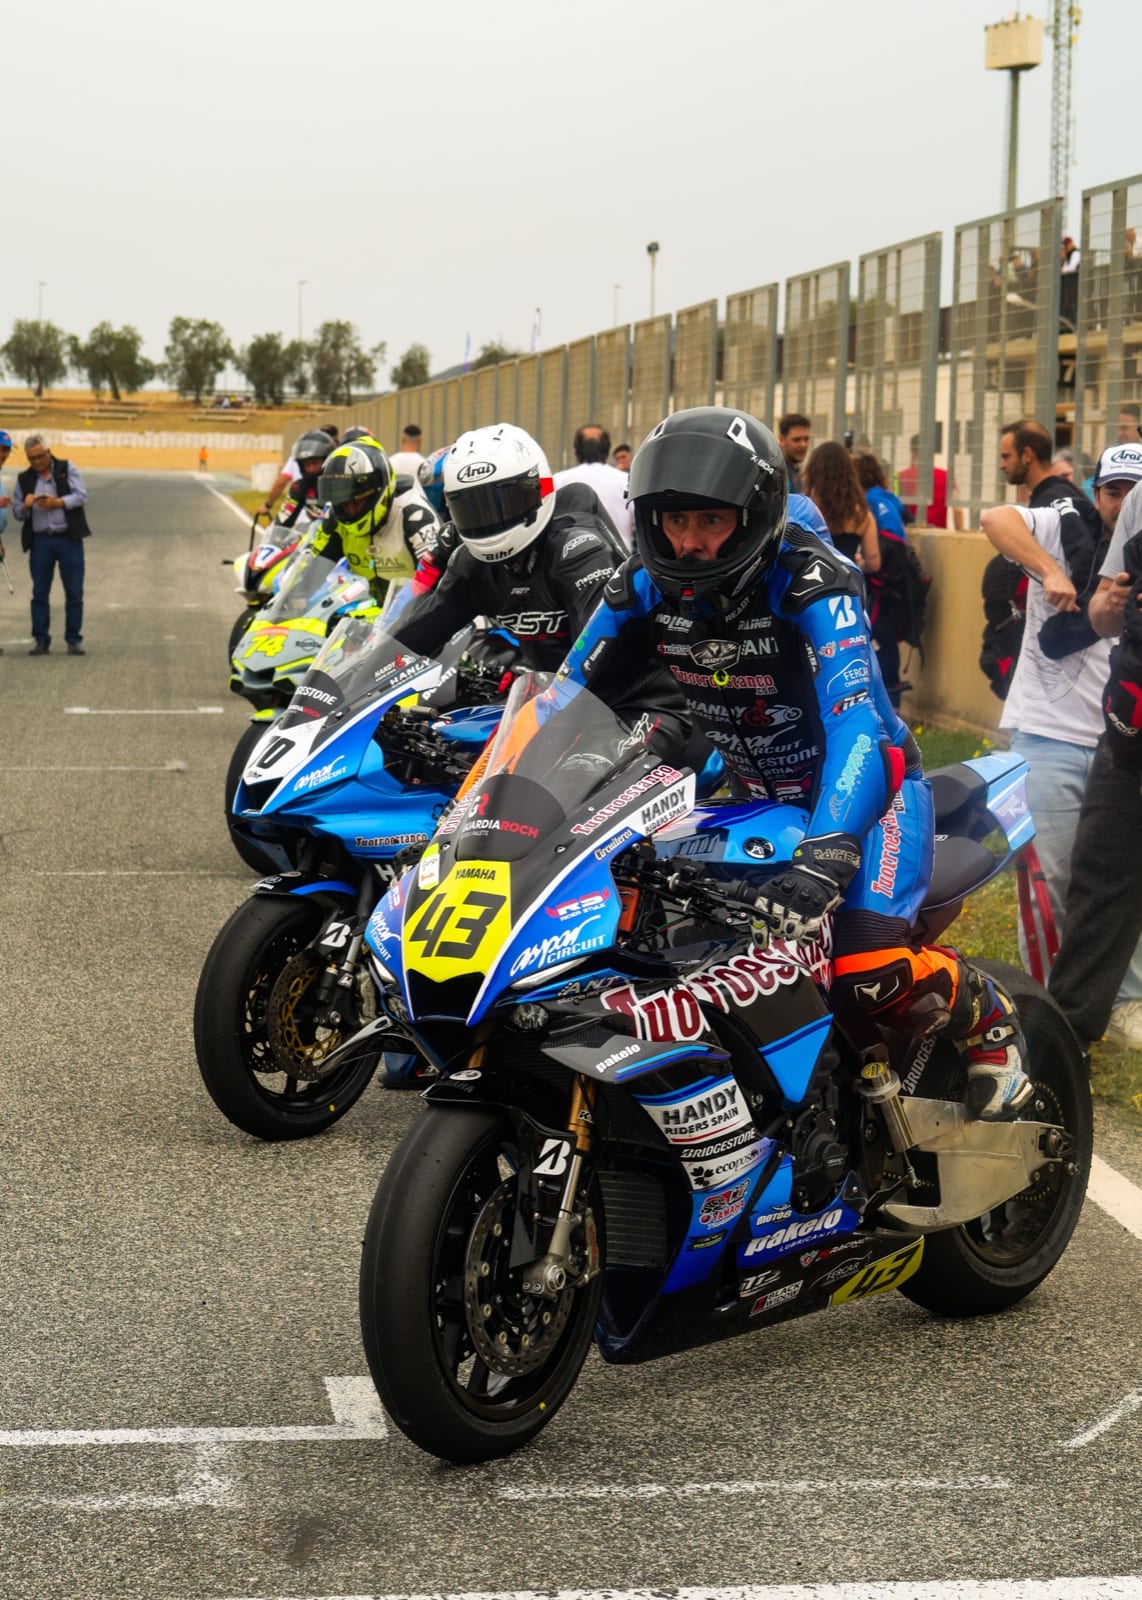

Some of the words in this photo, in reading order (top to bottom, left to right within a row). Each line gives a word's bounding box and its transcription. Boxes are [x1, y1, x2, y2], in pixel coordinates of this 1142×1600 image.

[459, 463, 492, 482] Arai
[496, 610, 569, 635] RST
[242, 634, 288, 659] 74
[570, 764, 674, 836] Tuotroestanco
[641, 785, 686, 825] HANDY
[669, 803, 688, 821] SPAIN
[455, 868, 497, 881] YAMAHA
[409, 890, 507, 959] 43
[546, 934, 606, 964] CIRCUIT
[594, 1043, 642, 1074] pakelo
[662, 1084, 739, 1125] HANDY
[664, 1120, 710, 1136] RIDERS
[711, 1106, 739, 1127] SPAIN
[680, 1127, 757, 1159] BRIDGESTONE
[744, 1208, 844, 1257] pakelo
[779, 1229, 839, 1252] LUBRICANTS
[848, 1243, 921, 1300] 43
